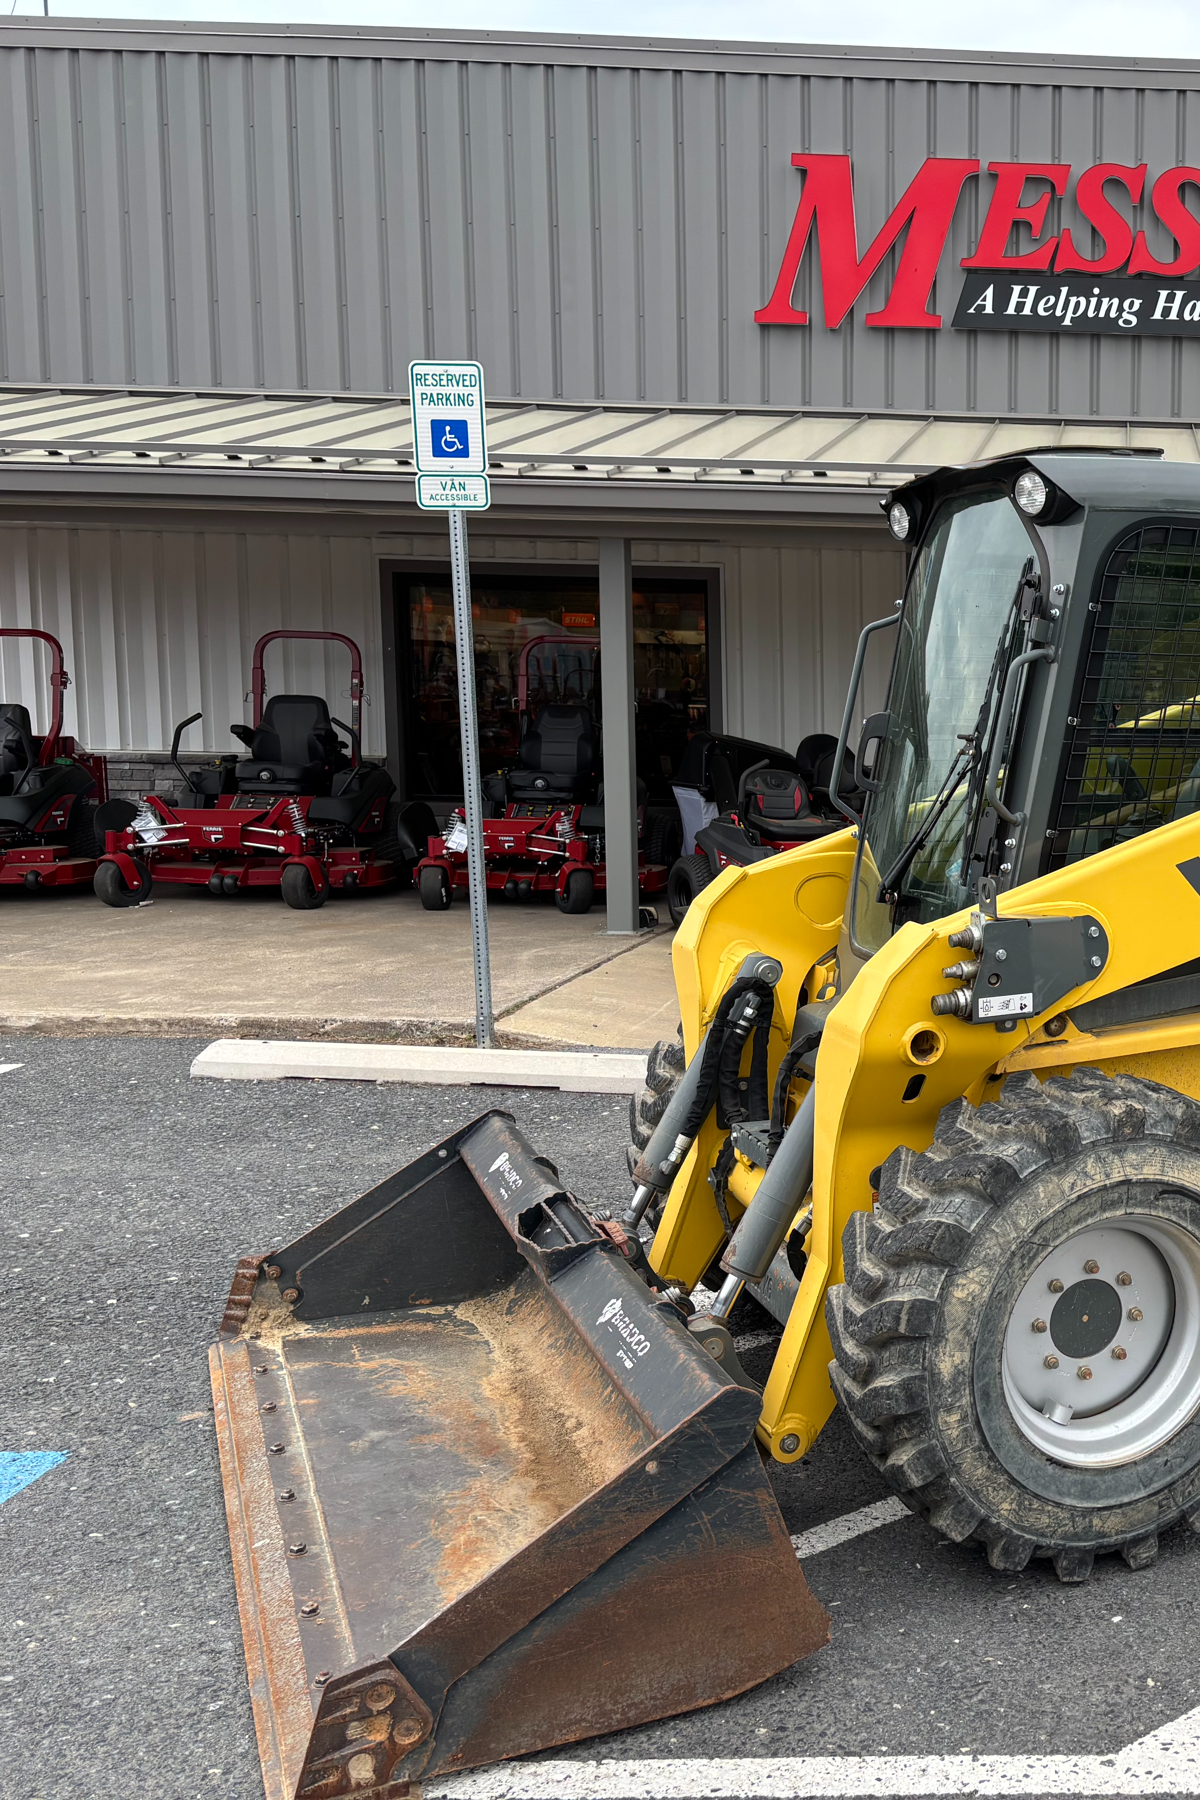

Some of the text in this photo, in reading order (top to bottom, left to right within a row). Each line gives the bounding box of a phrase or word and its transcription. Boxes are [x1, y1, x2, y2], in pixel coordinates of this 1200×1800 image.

[967, 283, 995, 314] A
[1003, 284, 1142, 328] Helping
[415, 373, 478, 388] RESERVED
[420, 392, 475, 407] PARKING
[440, 481, 467, 492] VAN
[429, 493, 479, 502] ACCESSIBLE
[565, 616, 590, 624] STIHL
